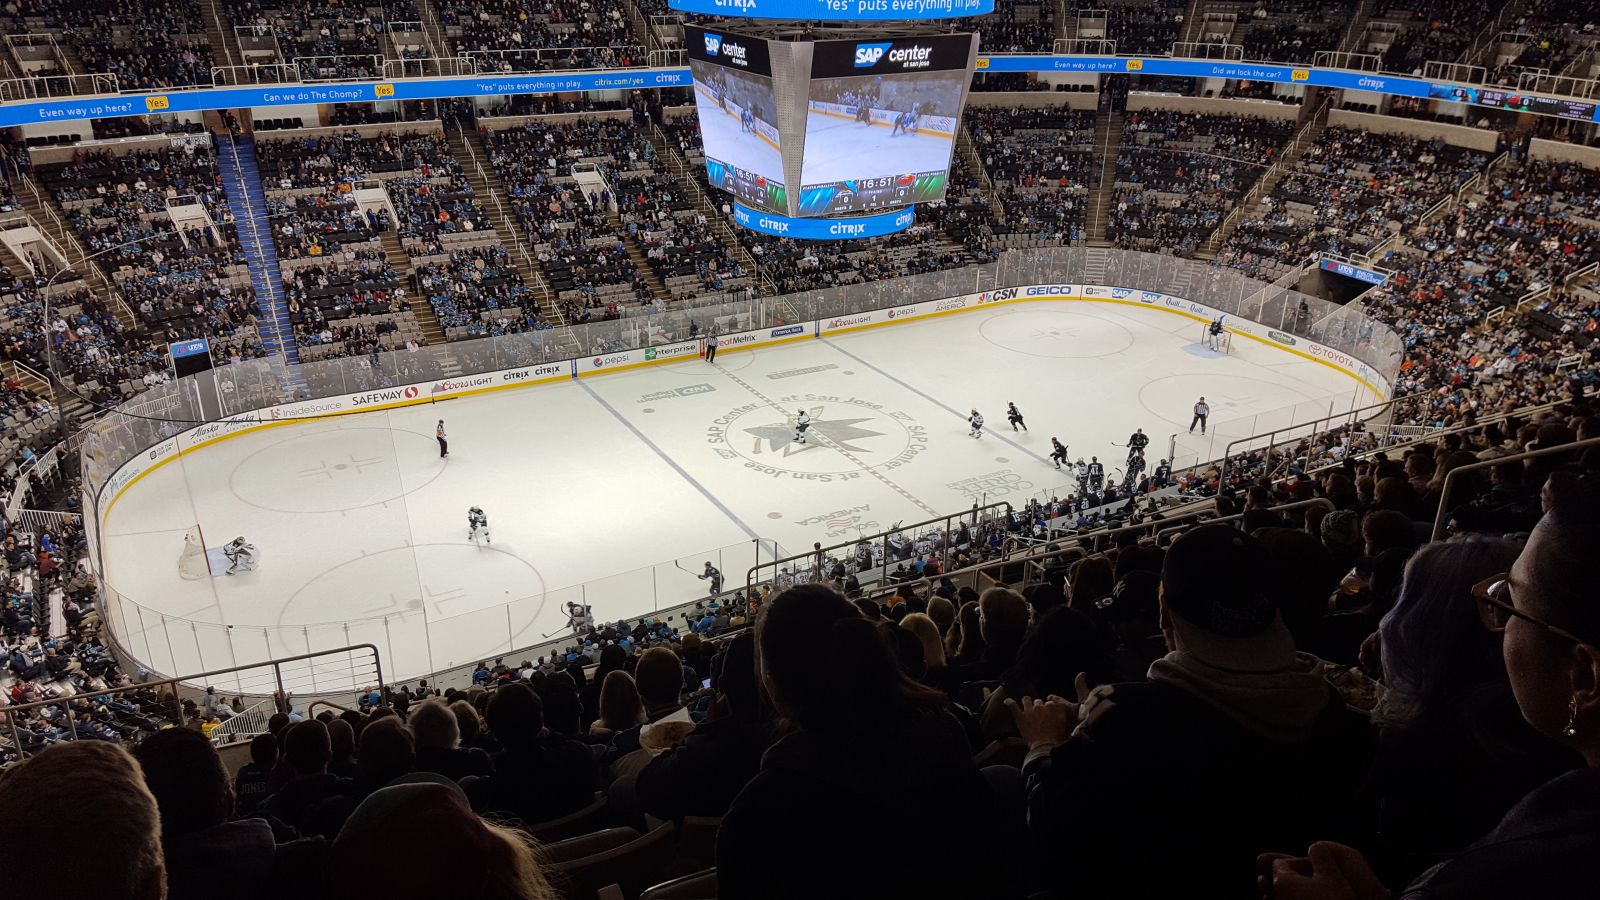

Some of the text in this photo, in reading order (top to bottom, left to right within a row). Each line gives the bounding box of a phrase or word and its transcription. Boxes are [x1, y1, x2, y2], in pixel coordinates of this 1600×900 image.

[858, 0, 888, 14] puts
[892, 0, 951, 13] everything
[704, 36, 746, 59] SAP center
[856, 45, 932, 63] SAP center
[1237, 68, 1250, 76] lock
[1253, 69, 1264, 77] the
[498, 84, 514, 92] puts
[516, 81, 555, 91] everything
[566, 80, 582, 89] play.
[595, 77, 644, 86] citrix.com/yes
[264, 93, 280, 101] Can
[298, 91, 308, 99] do
[311, 91, 326, 99] The
[329, 90, 363, 100] Chomp?
[376, 86, 392, 94] Yes.
[149, 99, 167, 107] Yes.
[40, 103, 132, 118] Even way up here?
[736, 169, 753, 182] 16:51
[862, 178, 892, 189] 16:51
[993, 288, 1018, 301] CSN
[1026, 286, 1071, 295] GEICO
[896, 308, 916, 317] pepsi
[935, 303, 966, 312] AMERICA
[720, 335, 756, 346] ealMetrix
[648, 344, 696, 358] enterprise
[1323, 348, 1354, 368] TOYOTA
[604, 354, 629, 366] pepsi
[442, 377, 493, 391] Coors LIGHT
[352, 390, 402, 406] SAFEWAY
[843, 396, 883, 410] Jose
[283, 401, 342, 417] InsideSource
[714, 402, 758, 425] Center
[223, 414, 254, 428] Alaska
[190, 425, 219, 440] Alaska
[708, 426, 724, 444] SAP
[908, 425, 928, 443] SAP
[885, 444, 926, 471] Center
[744, 462, 860, 482] at San Jose
[1162, 471, 1166, 479] 7
[950, 474, 1021, 492] CREEK
[794, 504, 870, 525] AMERICA
[241, 782, 266, 794] JONES
